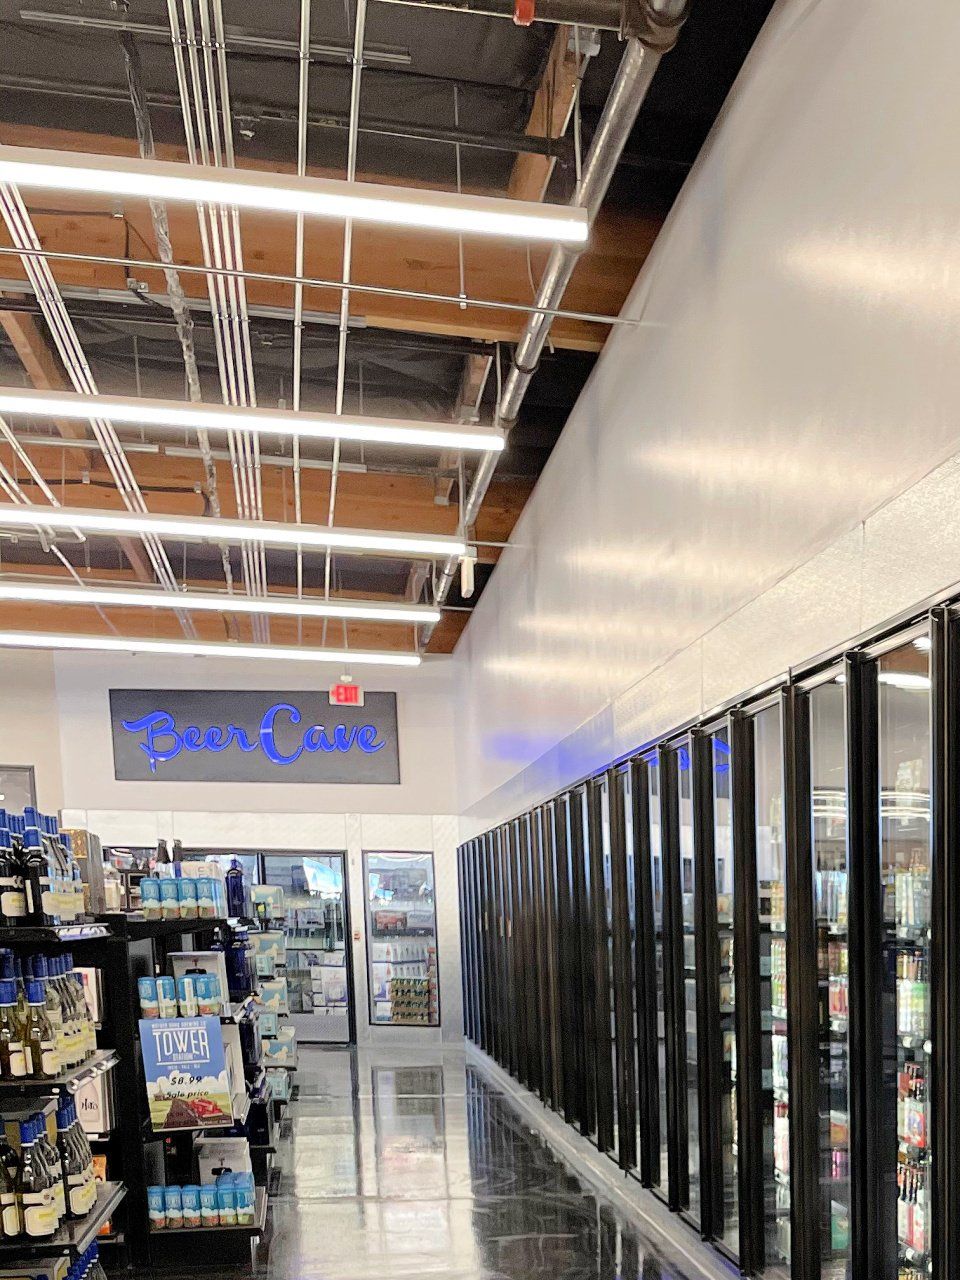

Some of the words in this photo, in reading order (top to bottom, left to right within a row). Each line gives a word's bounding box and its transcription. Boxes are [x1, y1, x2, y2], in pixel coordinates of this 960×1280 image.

[121, 709, 259, 774] Beer
[259, 703, 387, 766] Cave
[152, 1030, 210, 1062] TOWER
[170, 1075, 203, 1086] $8.99
